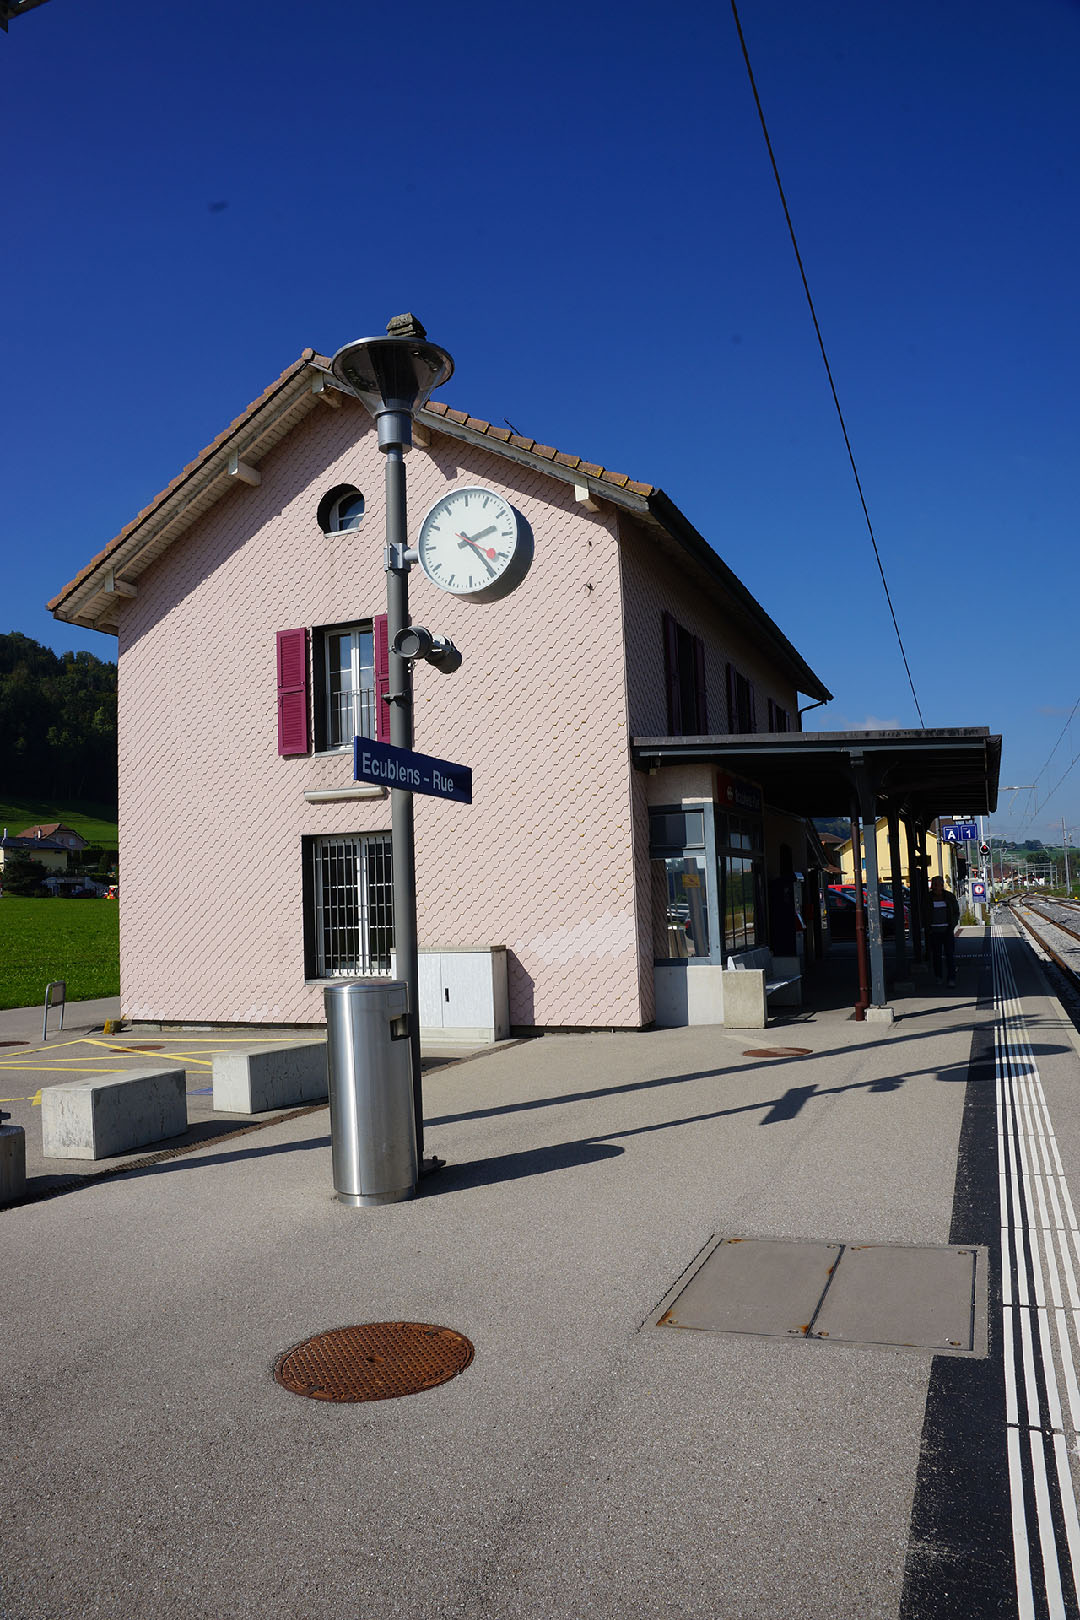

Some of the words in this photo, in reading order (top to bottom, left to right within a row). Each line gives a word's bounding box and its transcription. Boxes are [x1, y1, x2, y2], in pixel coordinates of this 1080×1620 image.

[362, 752, 420, 786] Ecublens
[432, 769, 455, 793] Rue
[947, 830, 957, 840] A
[965, 829, 972, 839] 1
